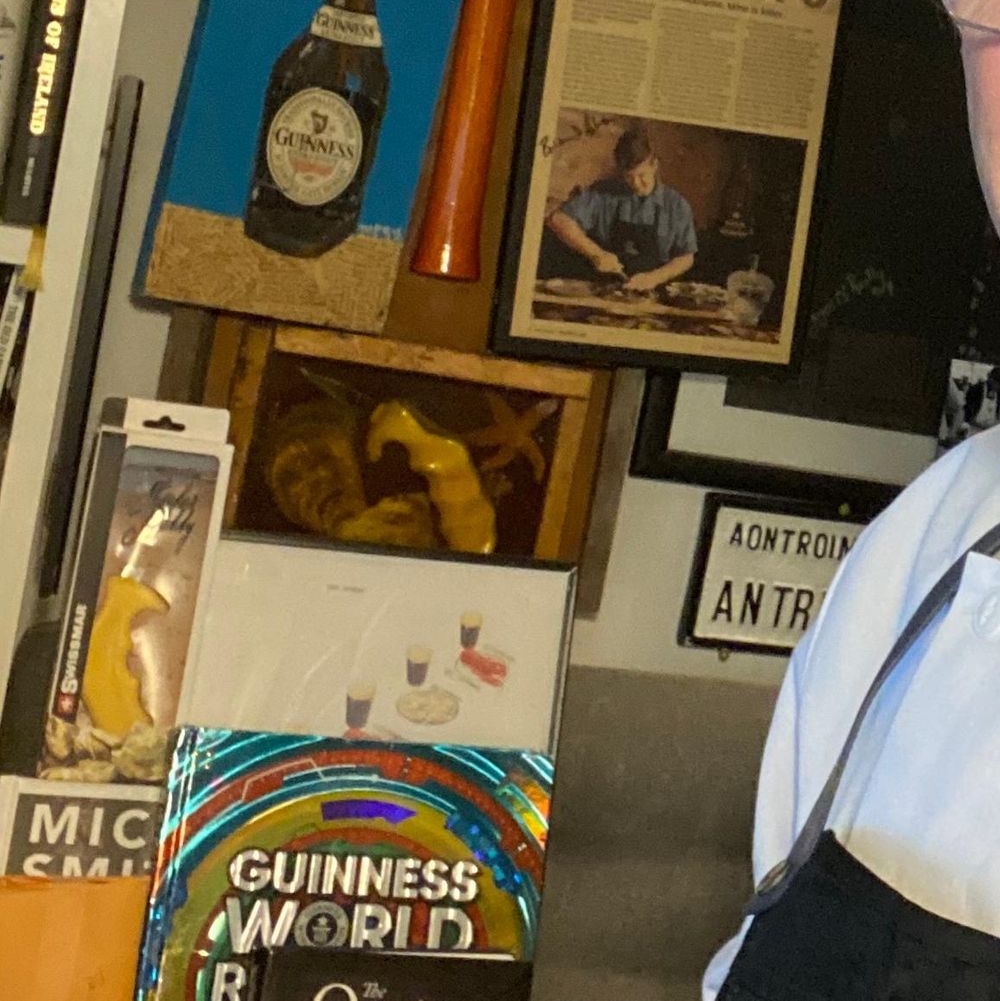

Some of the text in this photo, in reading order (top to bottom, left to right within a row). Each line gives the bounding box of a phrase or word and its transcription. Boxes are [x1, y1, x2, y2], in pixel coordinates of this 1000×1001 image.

[44, 20, 63, 50] OF
[315, 11, 376, 39] GUINNESS
[29, 52, 57, 136] IRELAND
[274, 126, 355, 159] GUINNESS
[712, 580, 820, 632] ANTR
[61, 603, 88, 695] SWISSMAR
[228, 848, 480, 902] GUINNESS
